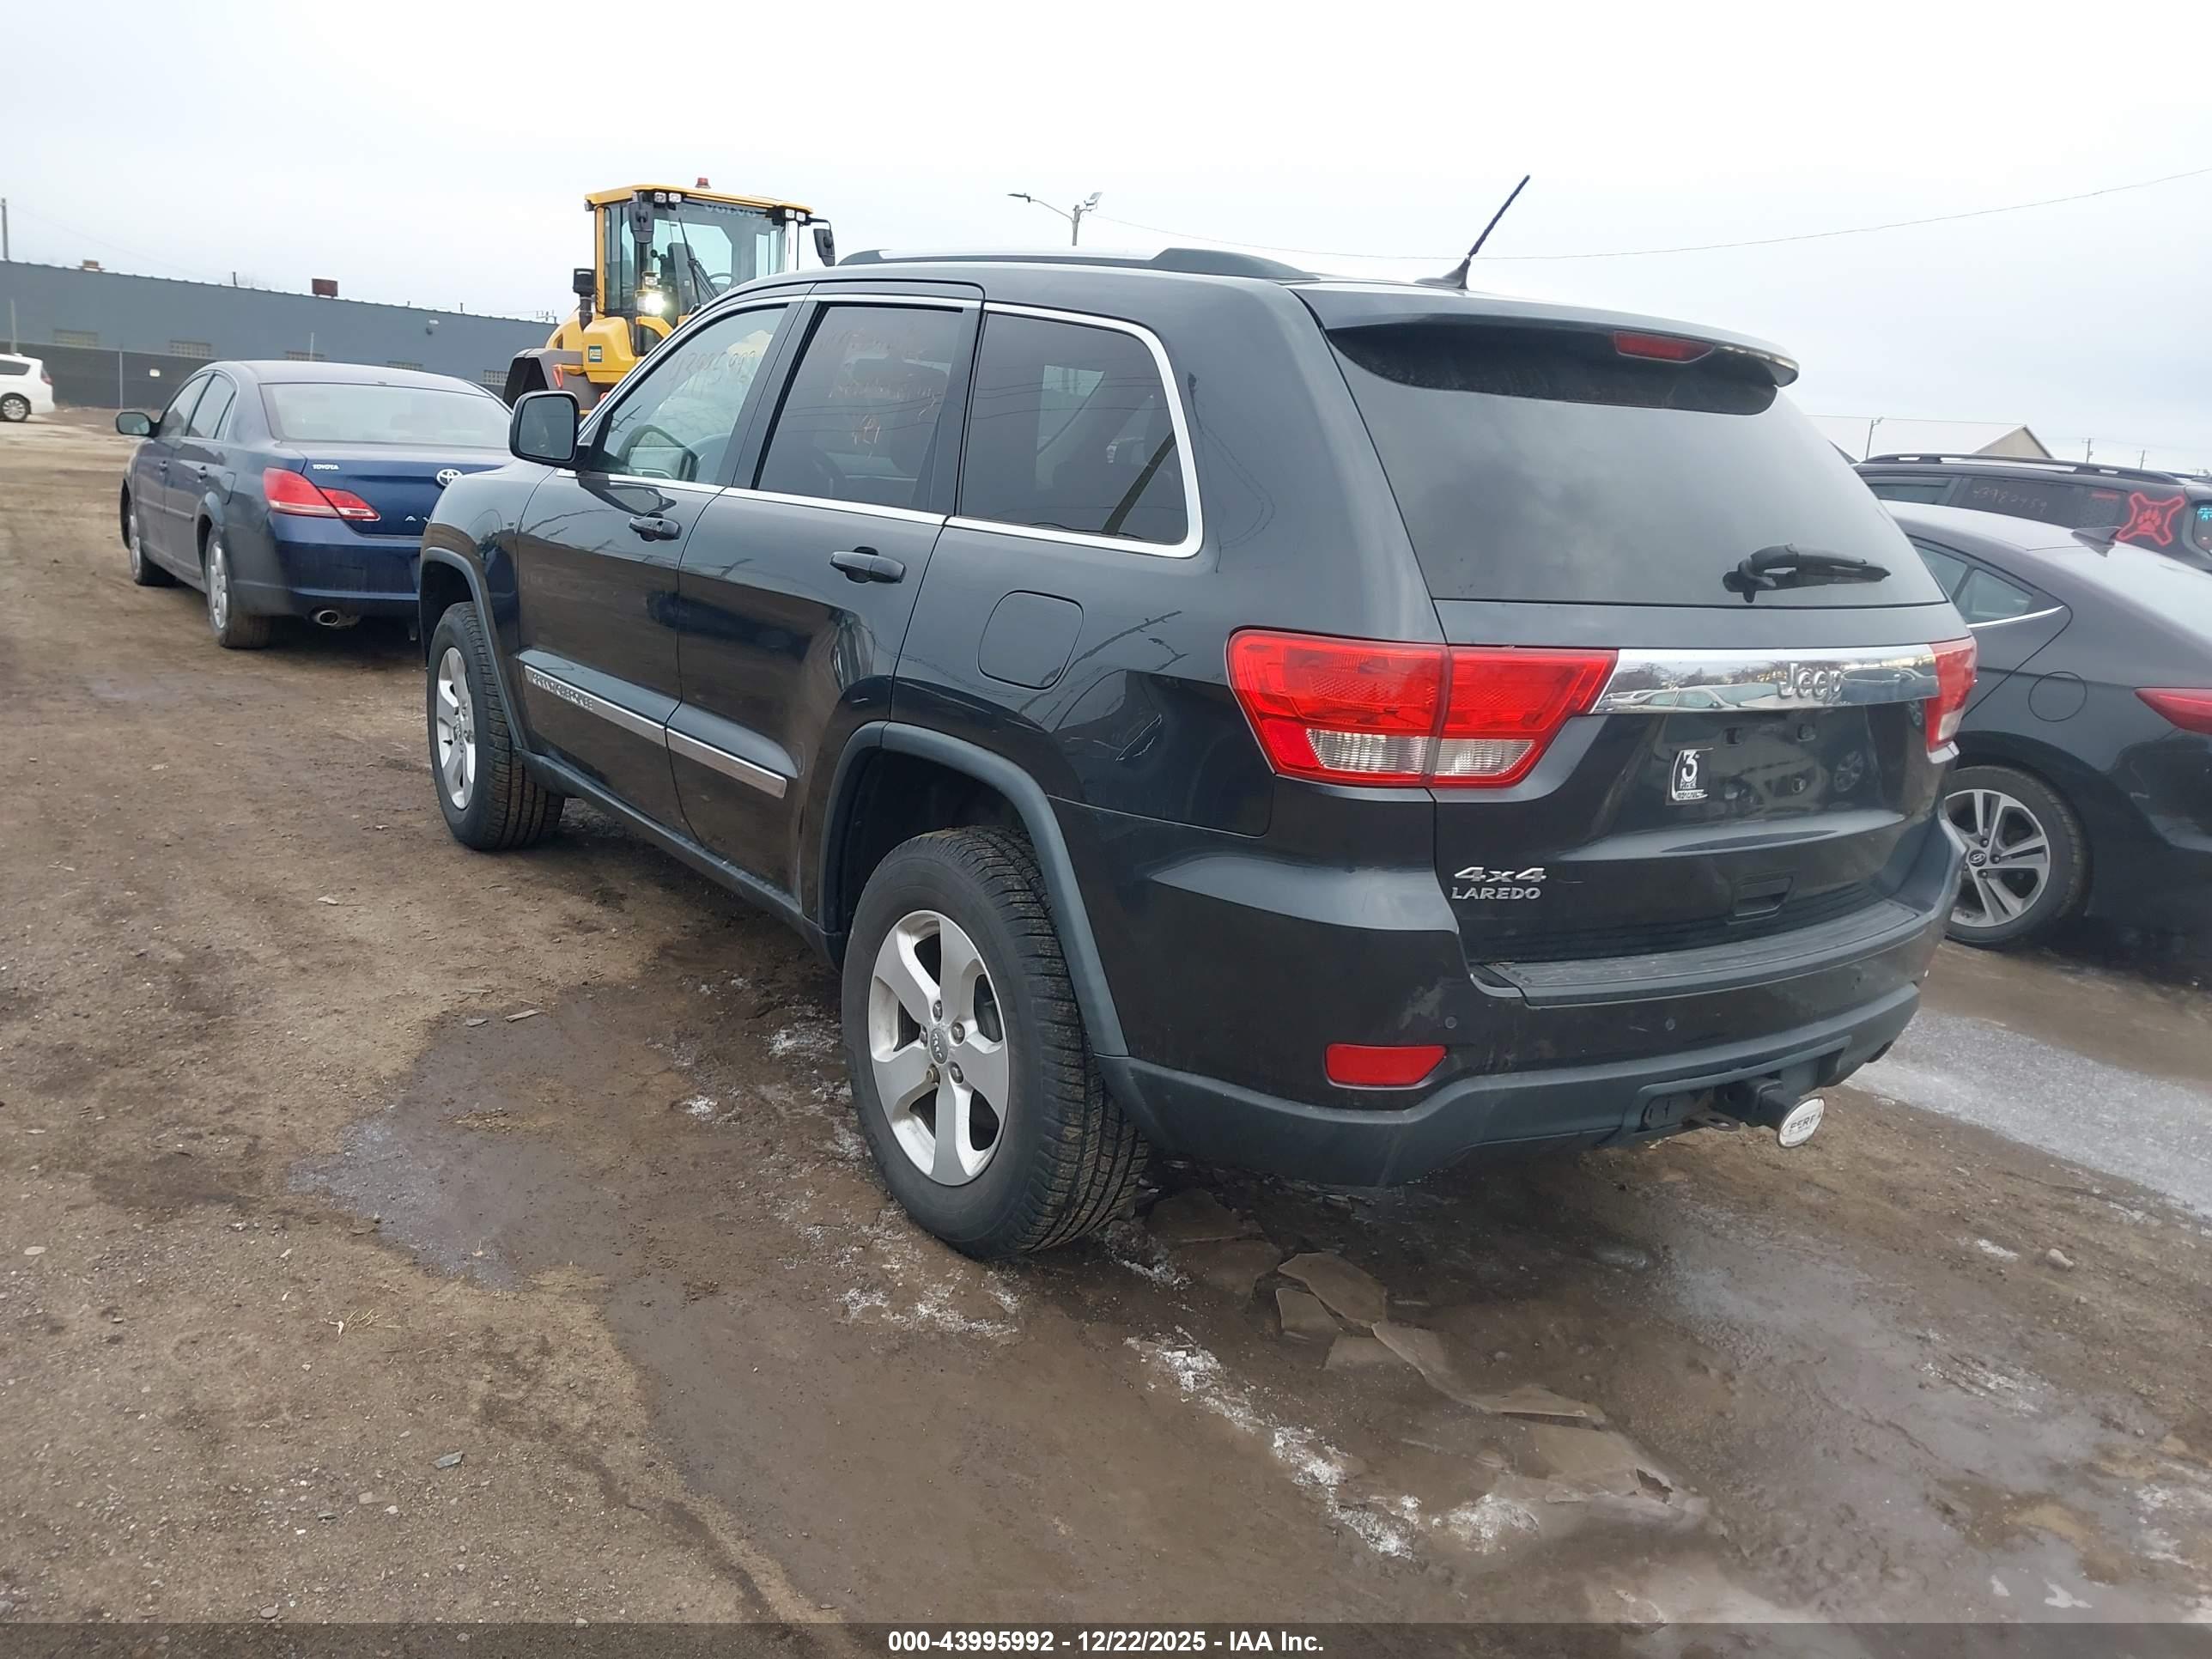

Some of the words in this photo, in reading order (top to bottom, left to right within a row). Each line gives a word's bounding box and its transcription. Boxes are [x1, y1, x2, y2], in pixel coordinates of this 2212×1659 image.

[704, 205, 757, 218] VOLVO
[1778, 661, 1842, 705] Jeep
[1454, 866, 1547, 883] 4x4
[1451, 886, 1541, 900] LAREDO
